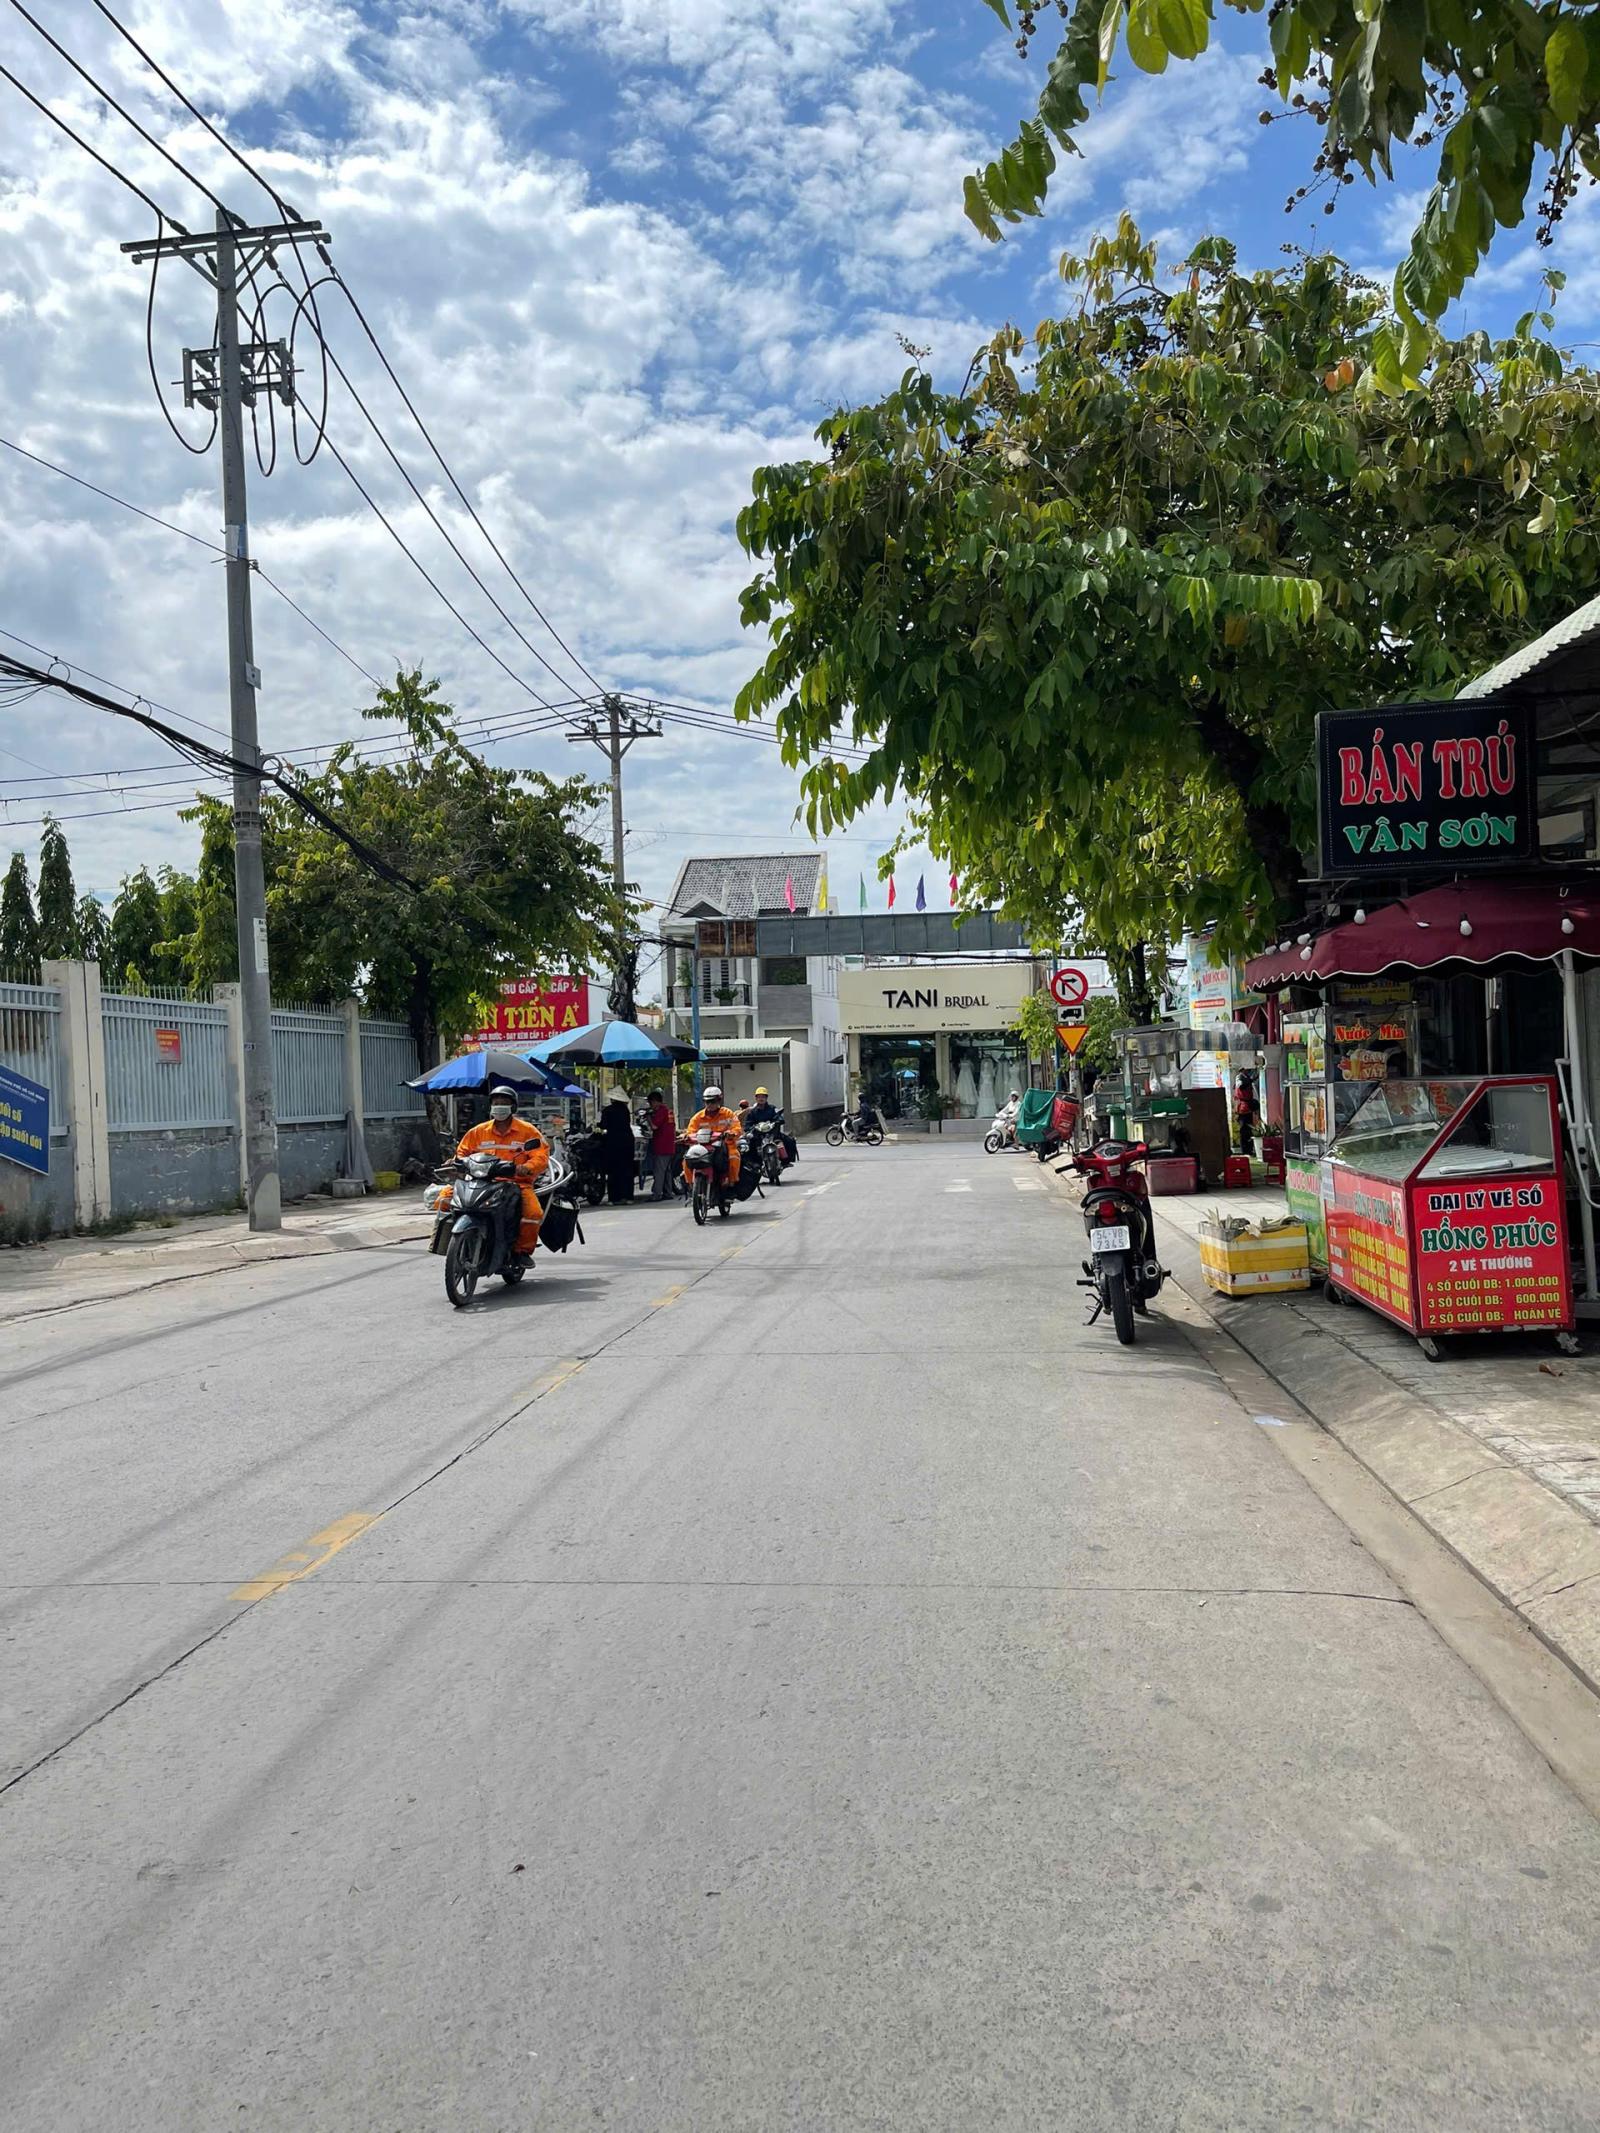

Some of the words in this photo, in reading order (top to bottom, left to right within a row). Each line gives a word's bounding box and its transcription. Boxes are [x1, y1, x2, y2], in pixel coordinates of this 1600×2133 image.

[1338, 728, 1423, 805] BÁN
[1432, 720, 1516, 799] TRÚ
[1343, 816, 1428, 853] VÂN
[1439, 812, 1517, 848] SƠN
[882, 989, 938, 1008] TANI
[944, 996, 989, 1009] BRIDAL
[1429, 1193, 1461, 1214] ĐẠI
[1465, 1189, 1485, 1210] LÝ
[1489, 1188, 1513, 1208] VÉ
[1517, 1184, 1543, 1206] SỐ
[1421, 1216, 1488, 1253] HỒNG
[1492, 1216, 1557, 1249] PHÚC
[1449, 1260, 1457, 1272] 2
[1427, 1282, 1433, 1292] 4
[1437, 1278, 1451, 1291] SỐ
[1455, 1277, 1480, 1291] CUỐI
[1483, 1279, 1502, 1289] ĐB:
[1505, 1276, 1559, 1288] 1.000.000
[1428, 1299, 1435, 1308] 3
[1438, 1295, 1452, 1307] SỐ
[1456, 1293, 1481, 1306] CUỐI
[1485, 1295, 1503, 1305] ĐB:
[1516, 1292, 1560, 1304] 600.000
[1430, 1314, 1437, 1324] 2
[1439, 1310, 1454, 1324] SỐ
[1457, 1308, 1483, 1322] CUỐI
[1486, 1311, 1504, 1321] ĐB:
